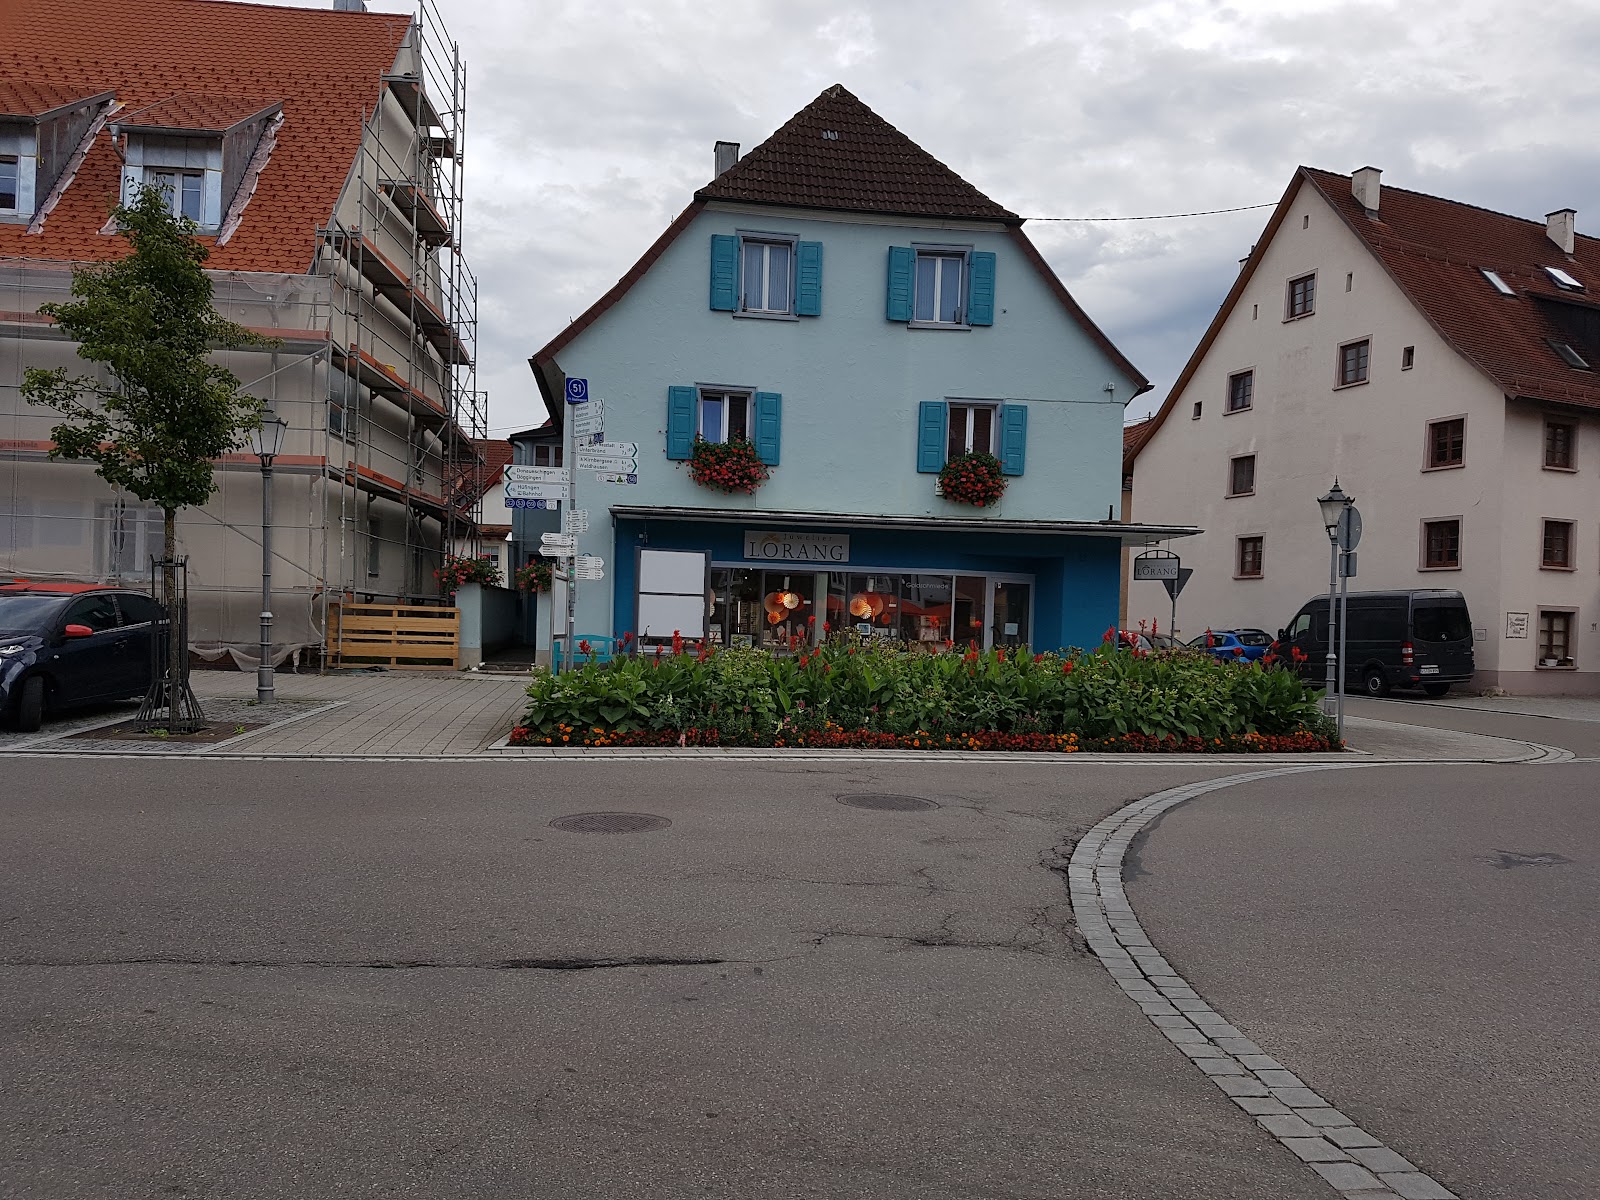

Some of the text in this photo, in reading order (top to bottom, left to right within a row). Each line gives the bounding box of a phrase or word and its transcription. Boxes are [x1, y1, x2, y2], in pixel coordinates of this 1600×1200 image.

[572, 383, 582, 393] 51
[783, 533, 833, 541] Juwelier
[749, 541, 844, 561] LORANG
[1137, 567, 1177, 576] LORANG
